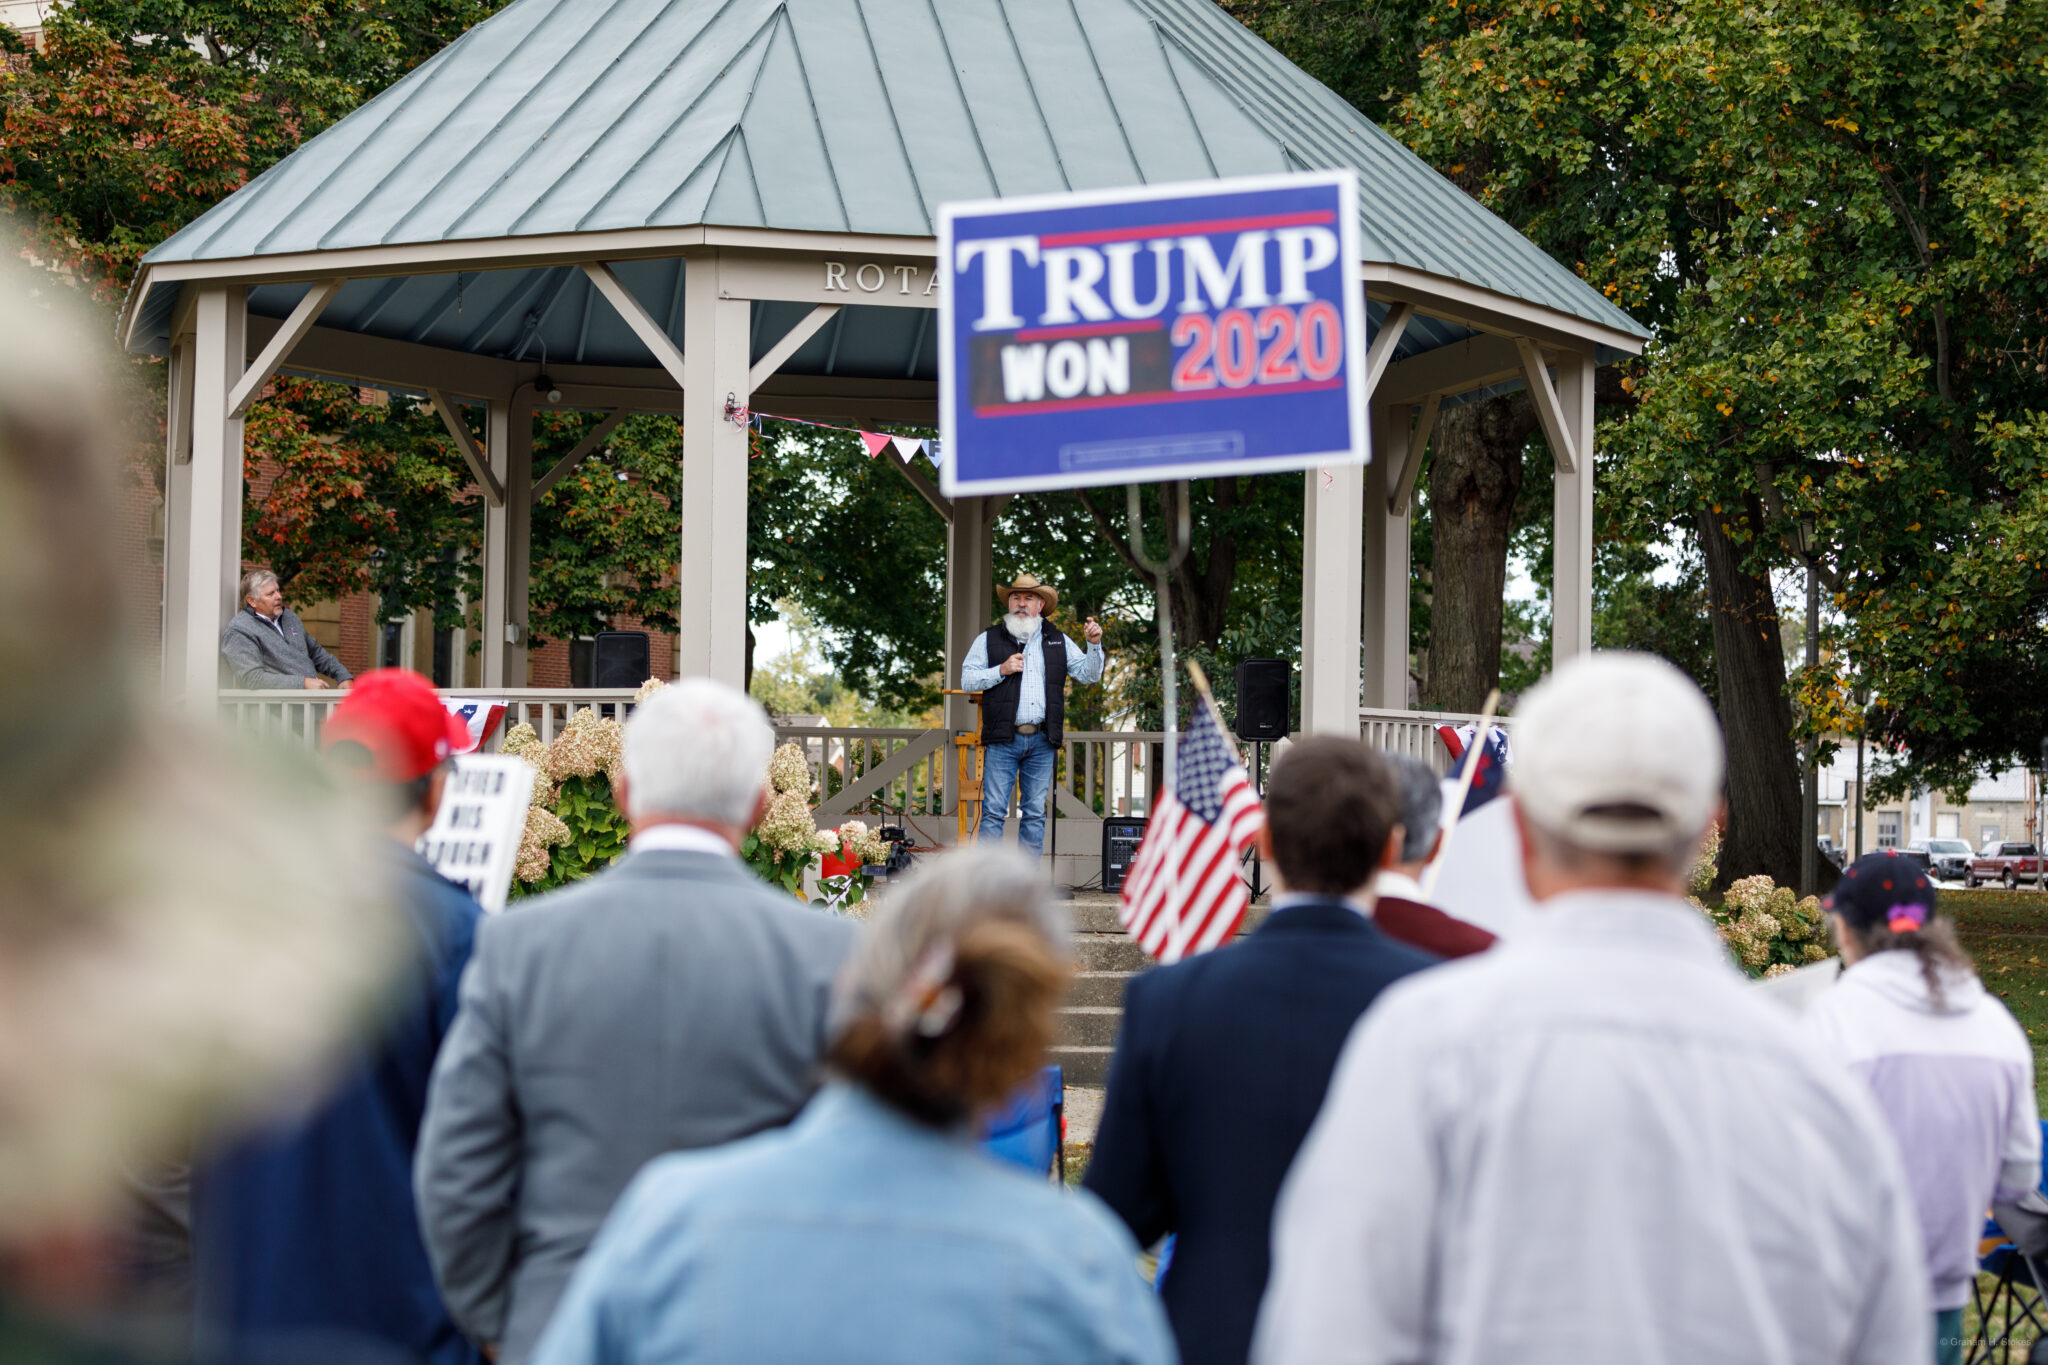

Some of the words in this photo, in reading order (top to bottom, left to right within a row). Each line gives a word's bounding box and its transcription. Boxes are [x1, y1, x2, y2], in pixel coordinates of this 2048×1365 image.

[955, 225, 1339, 331] TRUMP
[1001, 336, 1130, 403] WON
[1170, 299, 1343, 391] 2020
